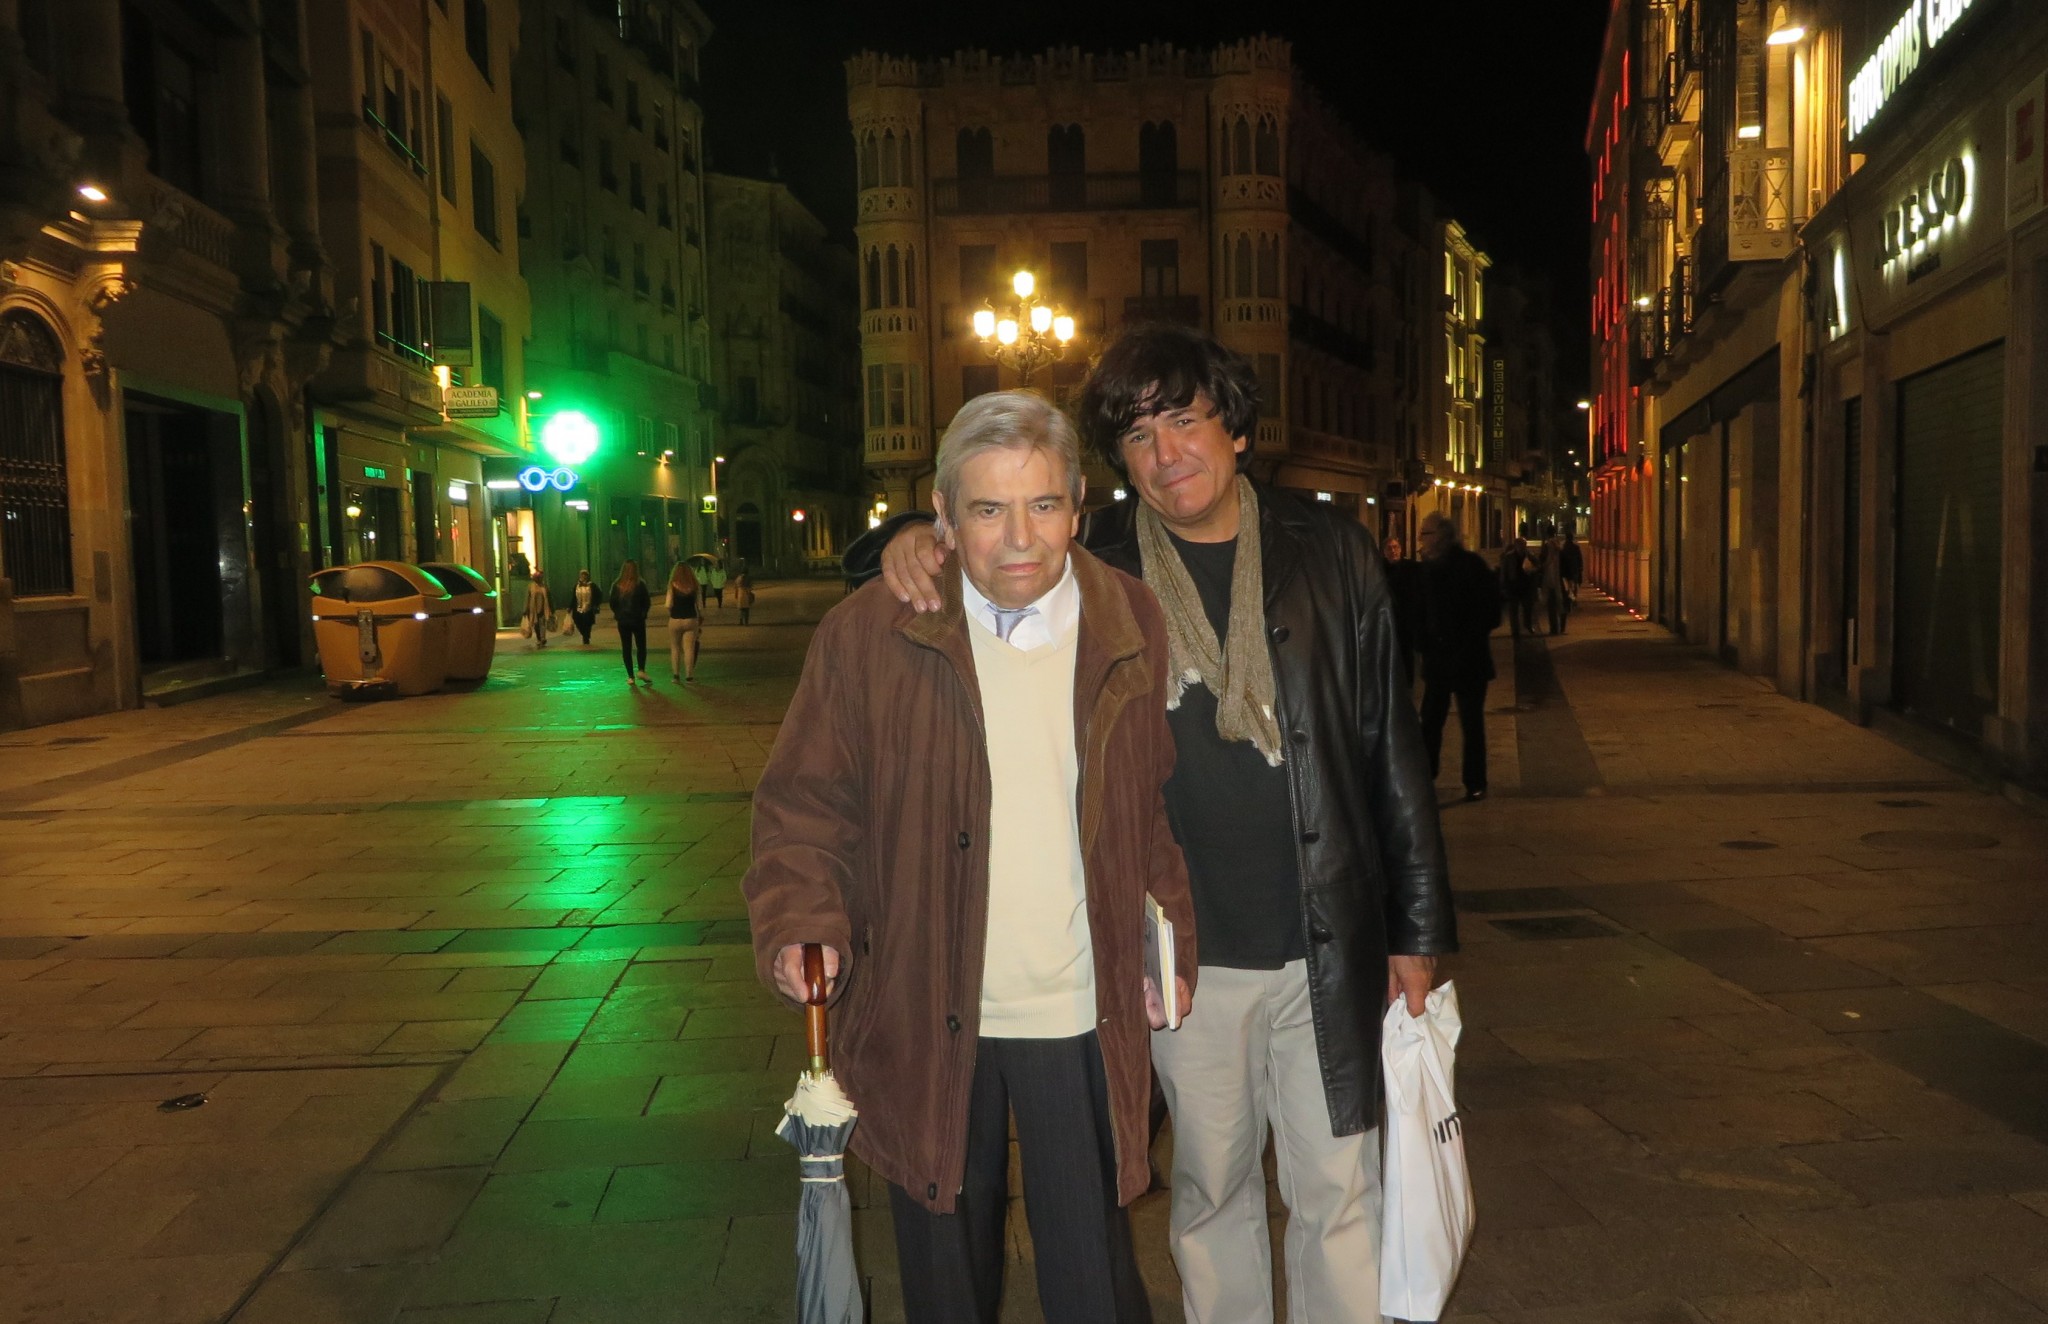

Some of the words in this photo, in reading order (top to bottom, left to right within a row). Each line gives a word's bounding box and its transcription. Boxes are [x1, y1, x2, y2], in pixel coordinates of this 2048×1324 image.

[1848, 0, 1921, 142] FOTOCOPIAS
[451, 390, 492, 399] ACADEMIA
[455, 399, 489, 407] GALILEO
[1494, 360, 1504, 464] CERVANTES
